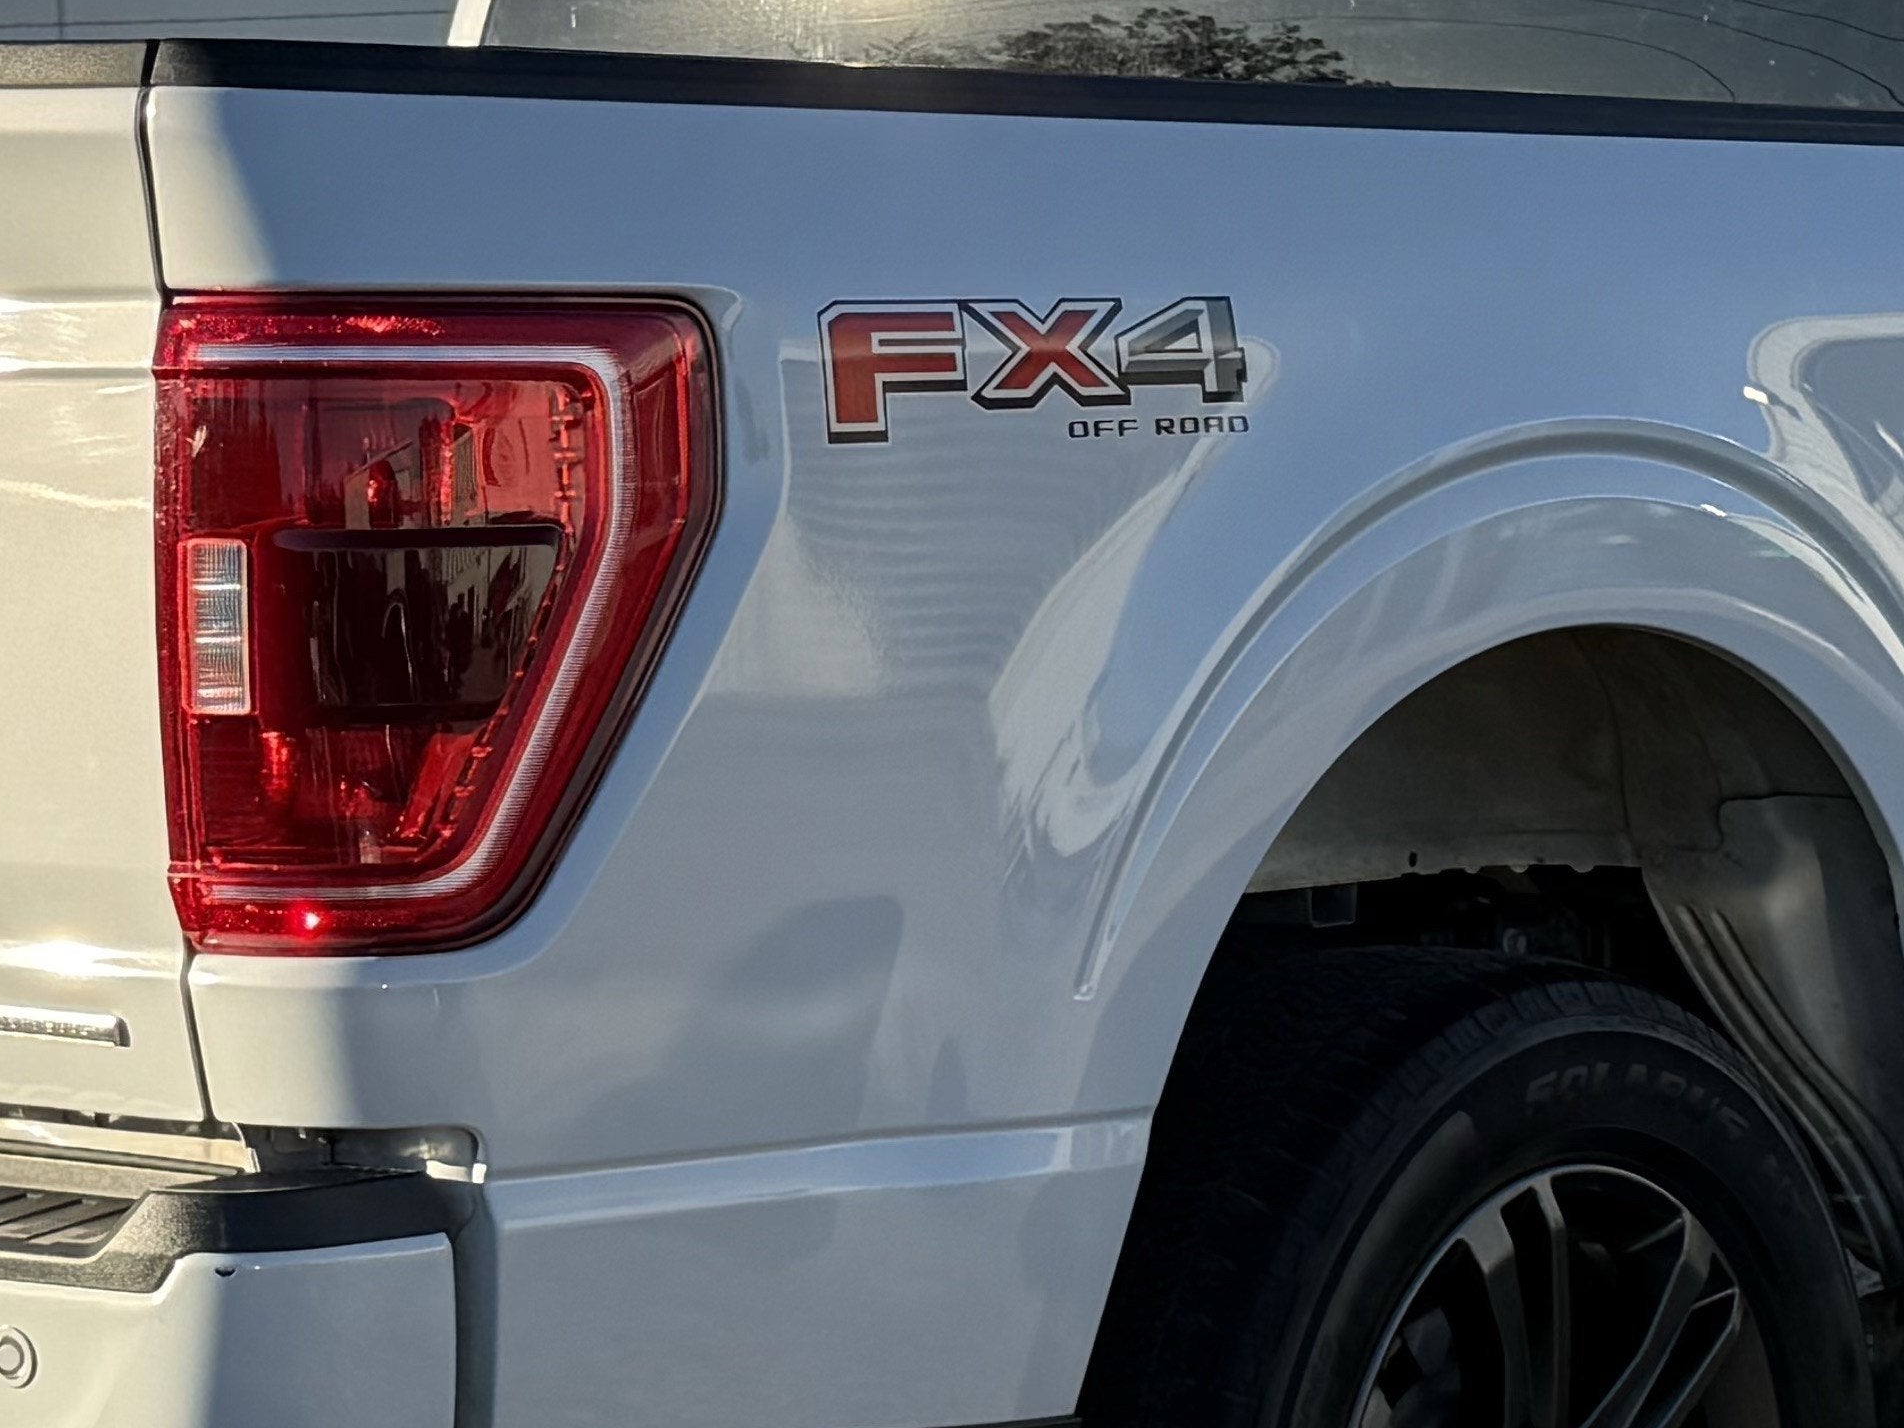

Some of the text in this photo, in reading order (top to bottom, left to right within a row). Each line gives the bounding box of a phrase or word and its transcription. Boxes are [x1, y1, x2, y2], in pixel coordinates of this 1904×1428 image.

[817, 296, 1248, 444] FX4
[1068, 415, 1249, 439] OFF ROAD
